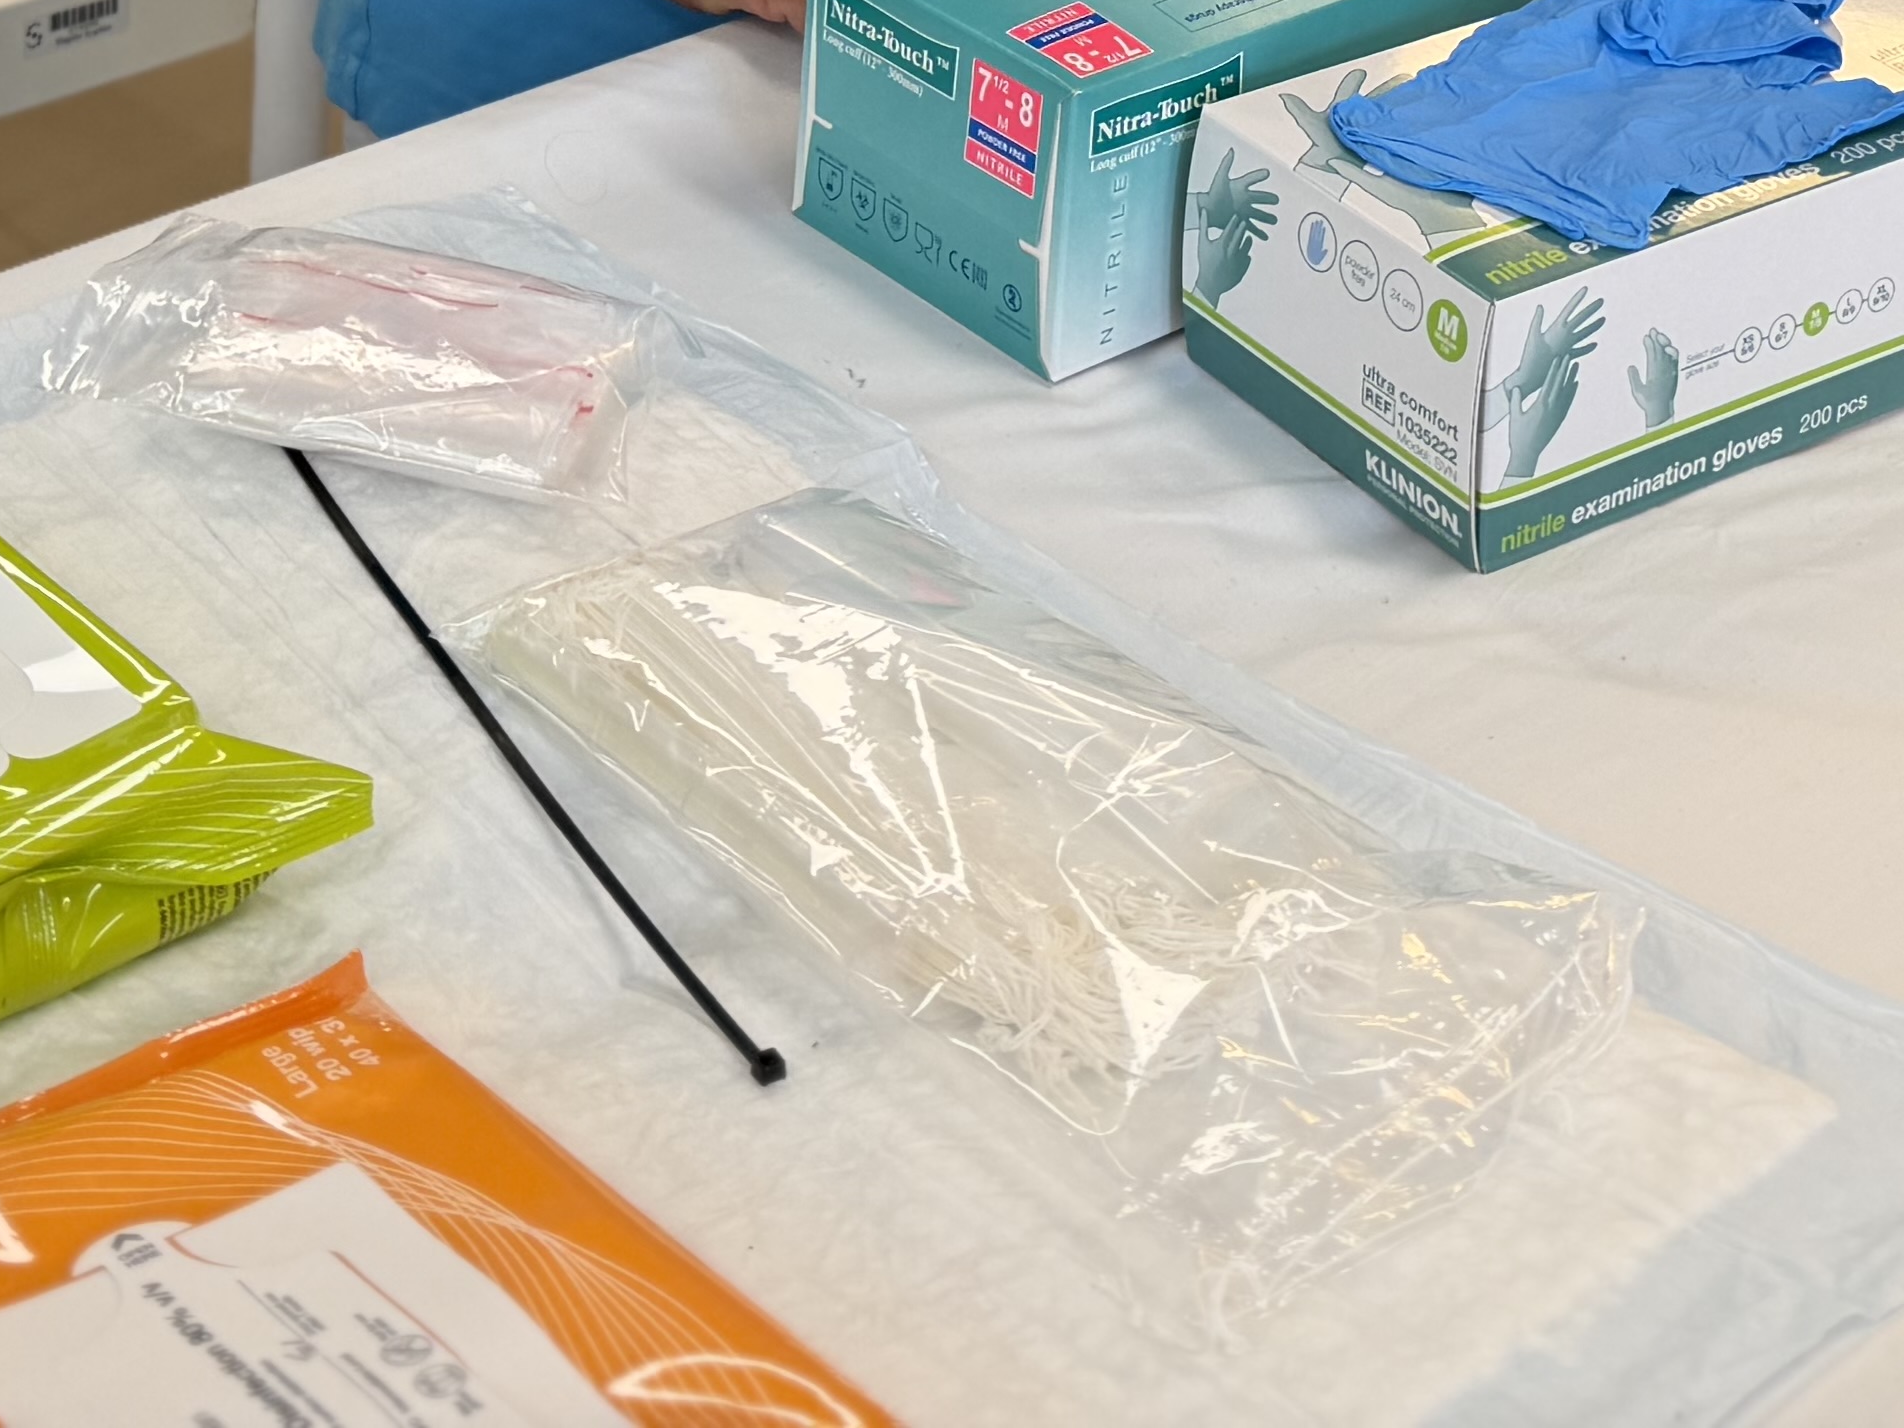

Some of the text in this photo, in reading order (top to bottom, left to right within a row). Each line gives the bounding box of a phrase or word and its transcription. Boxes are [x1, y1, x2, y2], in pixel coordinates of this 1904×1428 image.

[1063, 51, 1094, 73] 8
[1019, 92, 1034, 128] 8
[976, 151, 1024, 186] NITRILE
[1486, 247, 1569, 286] nitrile
[1734, 161, 1822, 205] gloves
[1830, 140, 1877, 165] 200
[1099, 174, 1129, 346] NITRILE
[1437, 307, 1460, 341] M
[1362, 364, 1459, 442] ultra comfort
[1365, 387, 1458, 466] REF 1035222
[1365, 448, 1461, 538] KLINION
[1500, 393, 1869, 553] nitrile examination gloves 200 pcs
[261, 1045, 319, 1099] Large
[288, 1027, 353, 1081] 20 wip
[348, 1048, 381, 1066] 40
